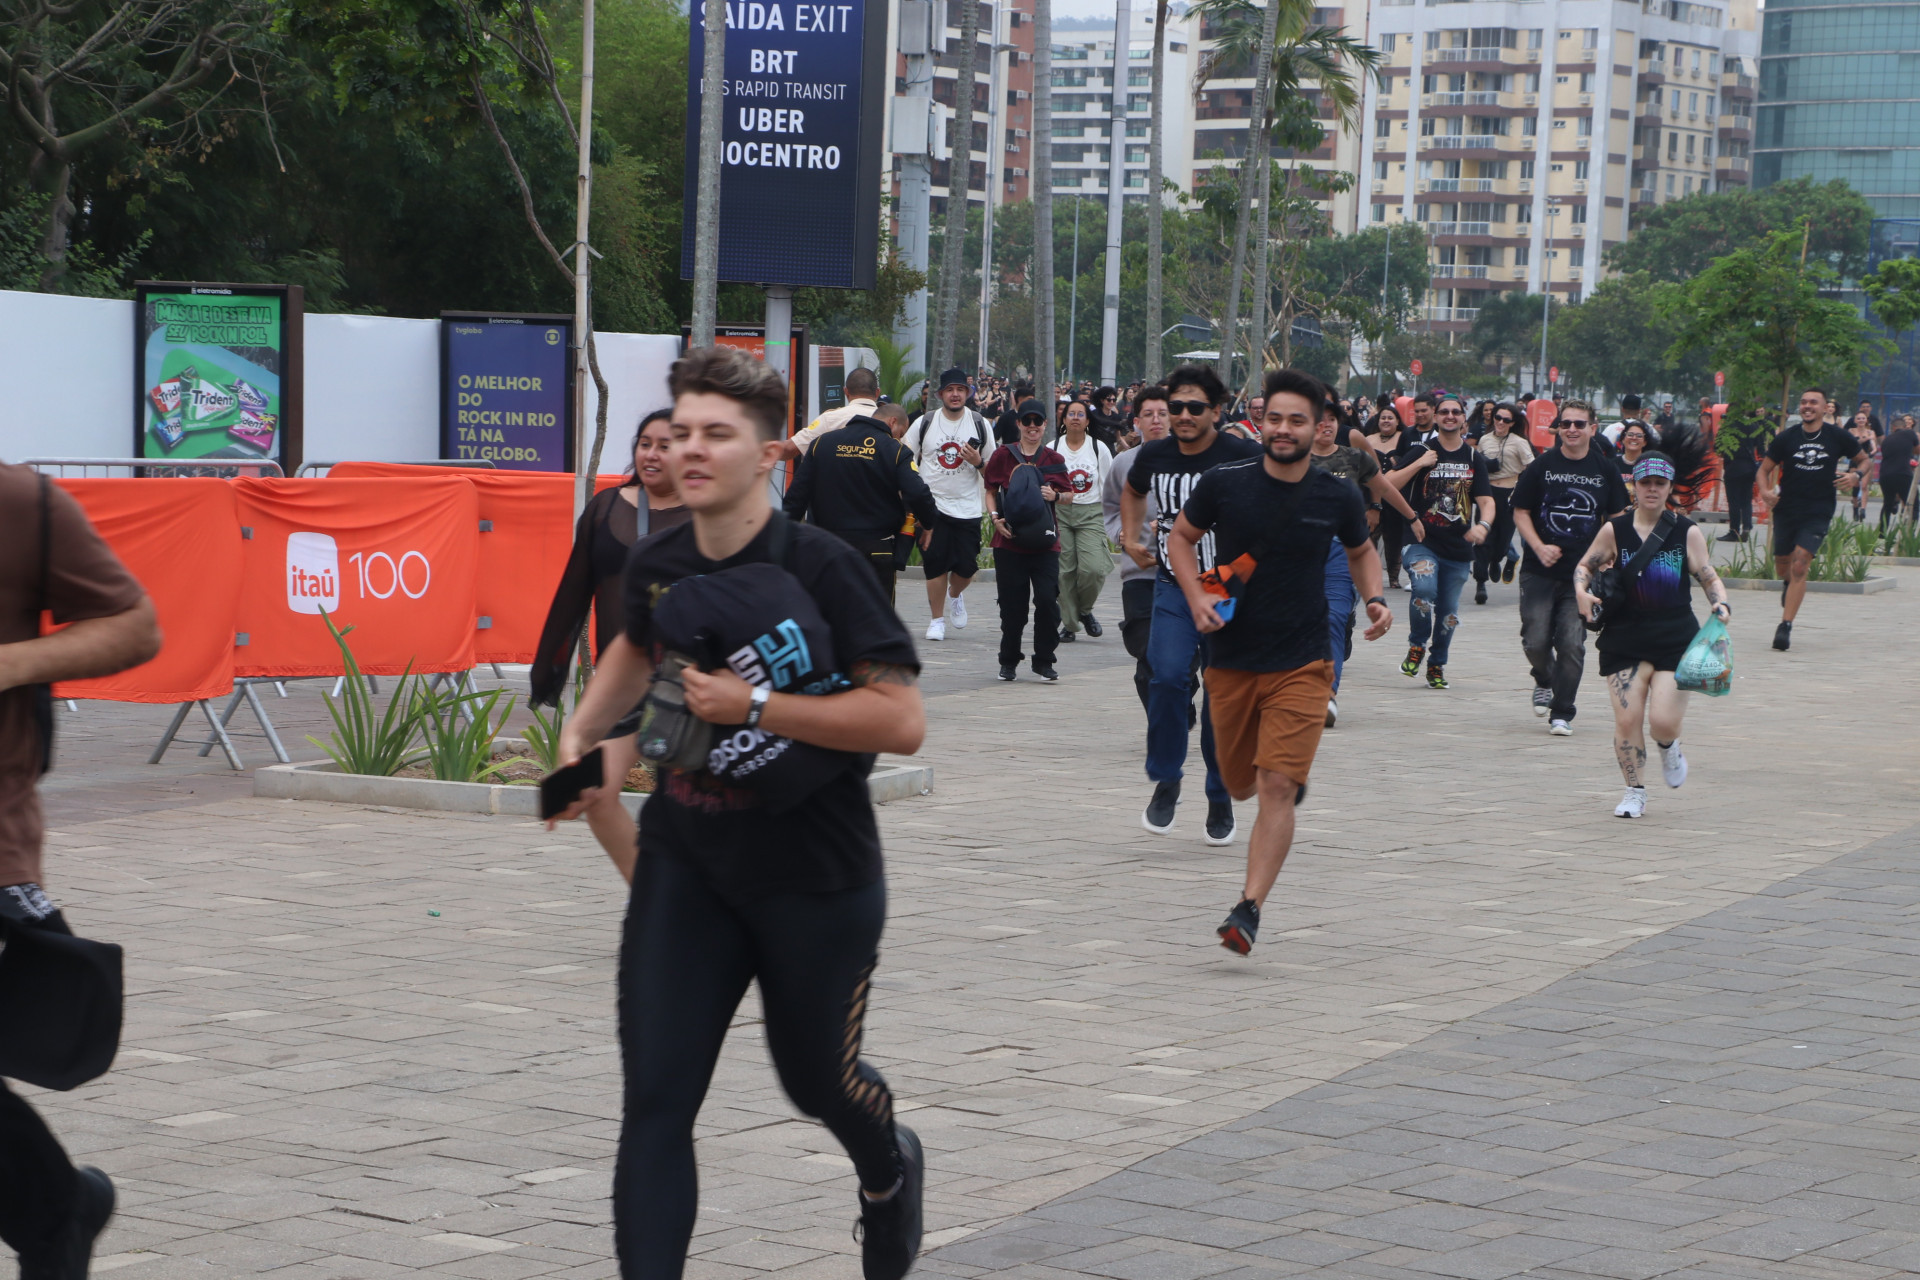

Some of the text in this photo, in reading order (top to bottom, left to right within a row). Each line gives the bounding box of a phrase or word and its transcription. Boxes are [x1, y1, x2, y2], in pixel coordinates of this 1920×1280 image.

[795, 4, 853, 33] EXIT
[750, 49, 798, 75] BRT
[735, 79, 779, 98] RAPID
[784, 82, 847, 100] TRANSIT
[739, 107, 805, 134] UBER
[720, 140, 841, 170] IOCENTRO
[157, 303, 272, 324] MASCA E DESTRAVA
[166, 324, 189, 338] SEU
[191, 325, 226, 344] ROCK
[227, 326, 239, 344] N
[455, 327, 483, 335] tvglobo
[458, 374, 542, 391] O MELHOR
[191, 389, 234, 406] Trident
[237, 385, 262, 405] Trident
[458, 392, 482, 407] DO
[164, 419, 181, 434] Trid
[458, 409, 556, 427] ROCK IN RIO
[457, 424, 505, 443] TÁ NA
[457, 445, 541, 462] TV GLOBO.
[291, 550, 431, 600] itaú 100
